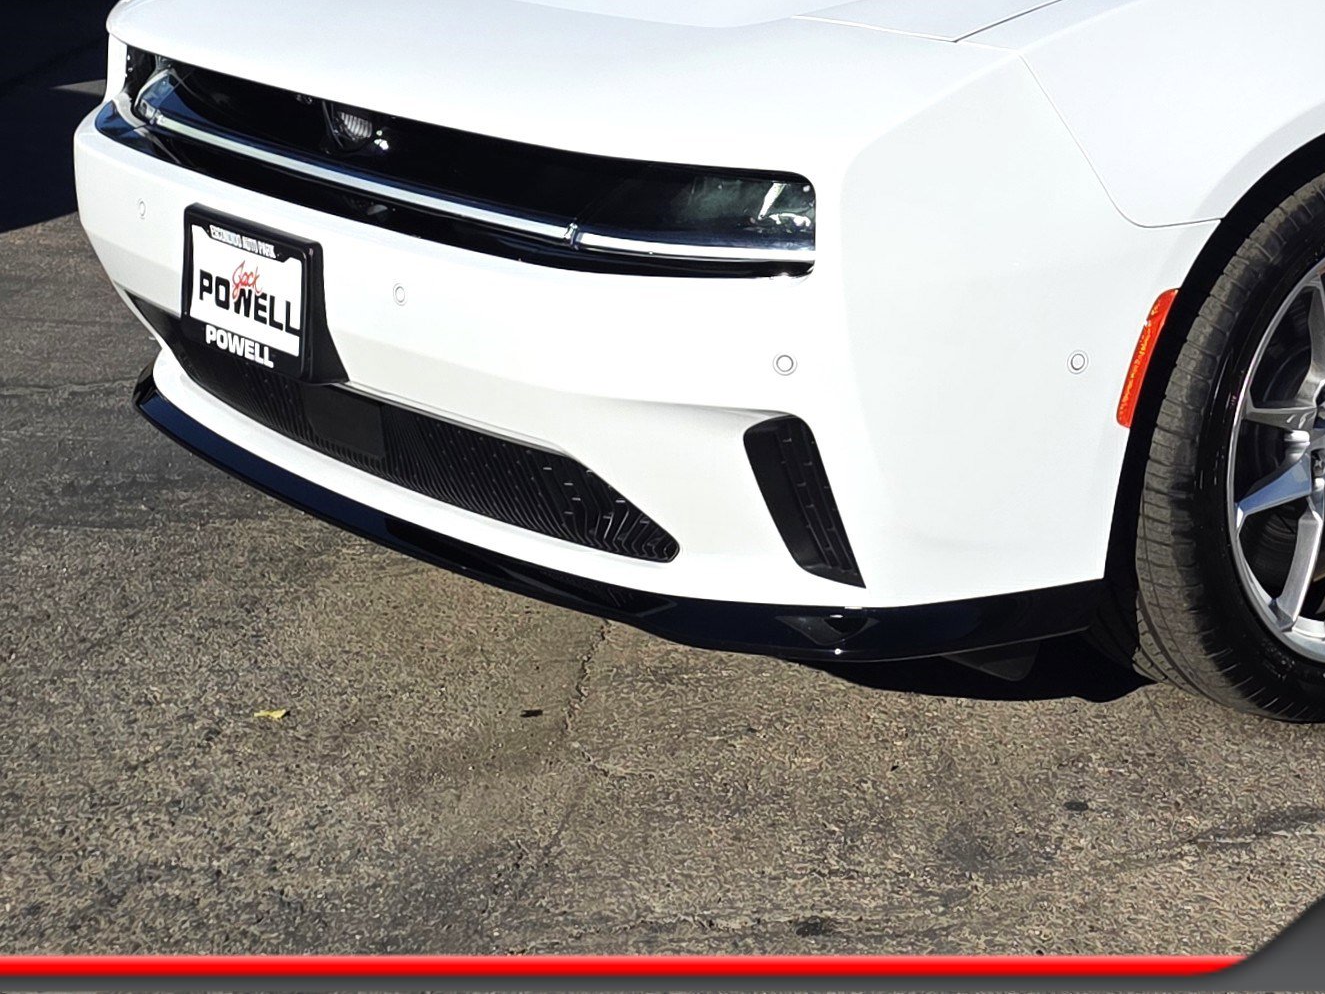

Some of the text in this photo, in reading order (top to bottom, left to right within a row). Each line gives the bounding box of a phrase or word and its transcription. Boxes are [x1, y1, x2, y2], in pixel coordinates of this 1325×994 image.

[199, 268, 301, 337] POWELL
[232, 259, 262, 301] Jack
[205, 324, 274, 369] POWELL
